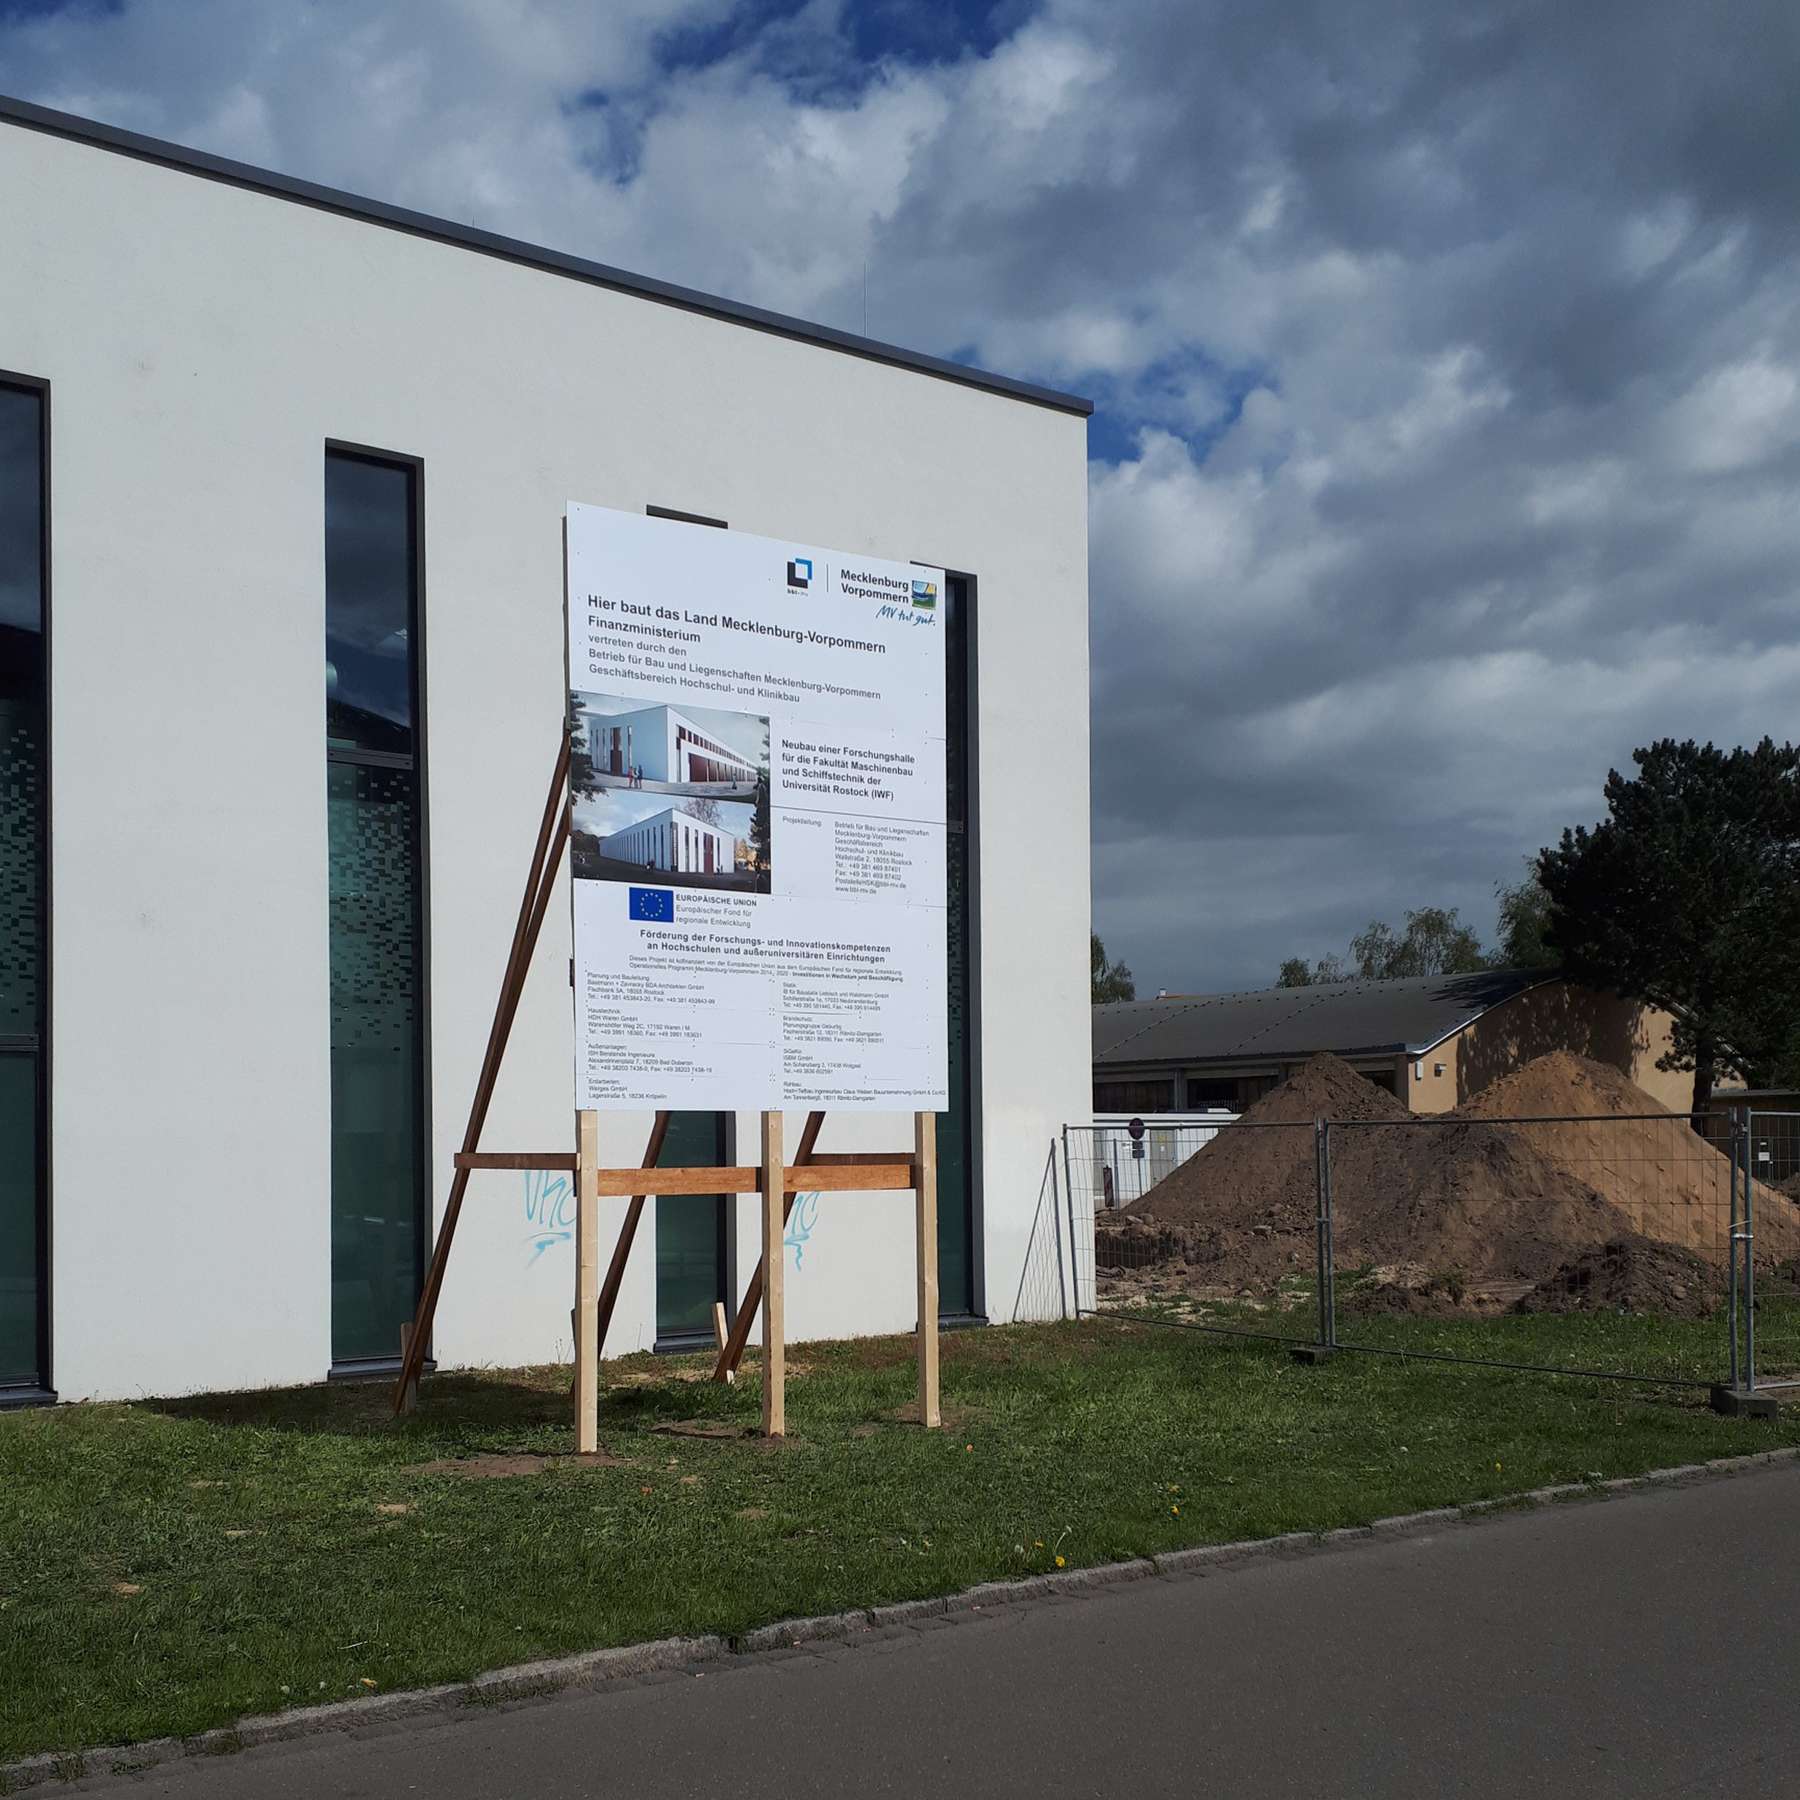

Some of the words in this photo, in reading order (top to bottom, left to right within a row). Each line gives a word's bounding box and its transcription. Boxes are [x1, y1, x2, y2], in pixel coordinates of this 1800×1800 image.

[840, 568, 909, 592] Mecklenburg
[842, 583, 909, 604] Vorpommern
[588, 594, 616, 610] Hier
[621, 600, 651, 616] baut
[656, 606, 680, 620] das
[684, 610, 718, 626] Land
[722, 616, 886, 653] Mecklenburg-Vorpommern
[876, 604, 898, 618] MV
[898, 610, 914, 622] tut
[588, 615, 701, 642] Finanzministerium
[588, 634, 634, 648] vertreten
[637, 641, 666, 652] durch
[668, 646, 686, 656] den
[589, 648, 625, 662] Betrieb
[628, 654, 642, 664] für
[645, 657, 664, 668] Bau
[668, 662, 686, 672] und
[690, 664, 761, 682] Liegenschaften
[764, 674, 880, 700] Mecklenburg-Vorpommern
[589, 664, 677, 685] Geschäftsbereich
[680, 677, 735, 692] Hochschul-
[738, 687, 754, 696] und
[758, 688, 800, 702] Klinikbau
[782, 739, 816, 752] Neubau
[818, 746, 840, 754] einer
[844, 746, 915, 764] Forschungshalle
[782, 752, 794, 762] für
[797, 754, 810, 764] die
[814, 756, 848, 768] Fakultät
[851, 762, 913, 776] Maschinenbau
[782, 768, 800, 776] und
[802, 768, 864, 784] Schiffstechnik
[867, 776, 882, 785] der
[782, 780, 830, 792] Universität
[833, 785, 869, 797] Rostock
[872, 790, 894, 801] (IWF)
[834, 822, 854, 830] Betrieb
[676, 894, 731, 906] EUROPÄISCHE
[734, 898, 757, 906] UNION
[676, 905, 722, 916] Europäischer
[676, 916, 708, 924] regionale
[711, 918, 751, 928] Entwicklung
[640, 930, 688, 942] Förderung
[692, 933, 706, 942] der
[710, 934, 765, 946] Forschungs-
[786, 940, 890, 952] Innovationskompetenzen
[662, 942, 720, 954] Hochschulen
[724, 946, 740, 954] und
[744, 948, 824, 960] außeruniversitären
[827, 952, 886, 964] Einrichtungen
